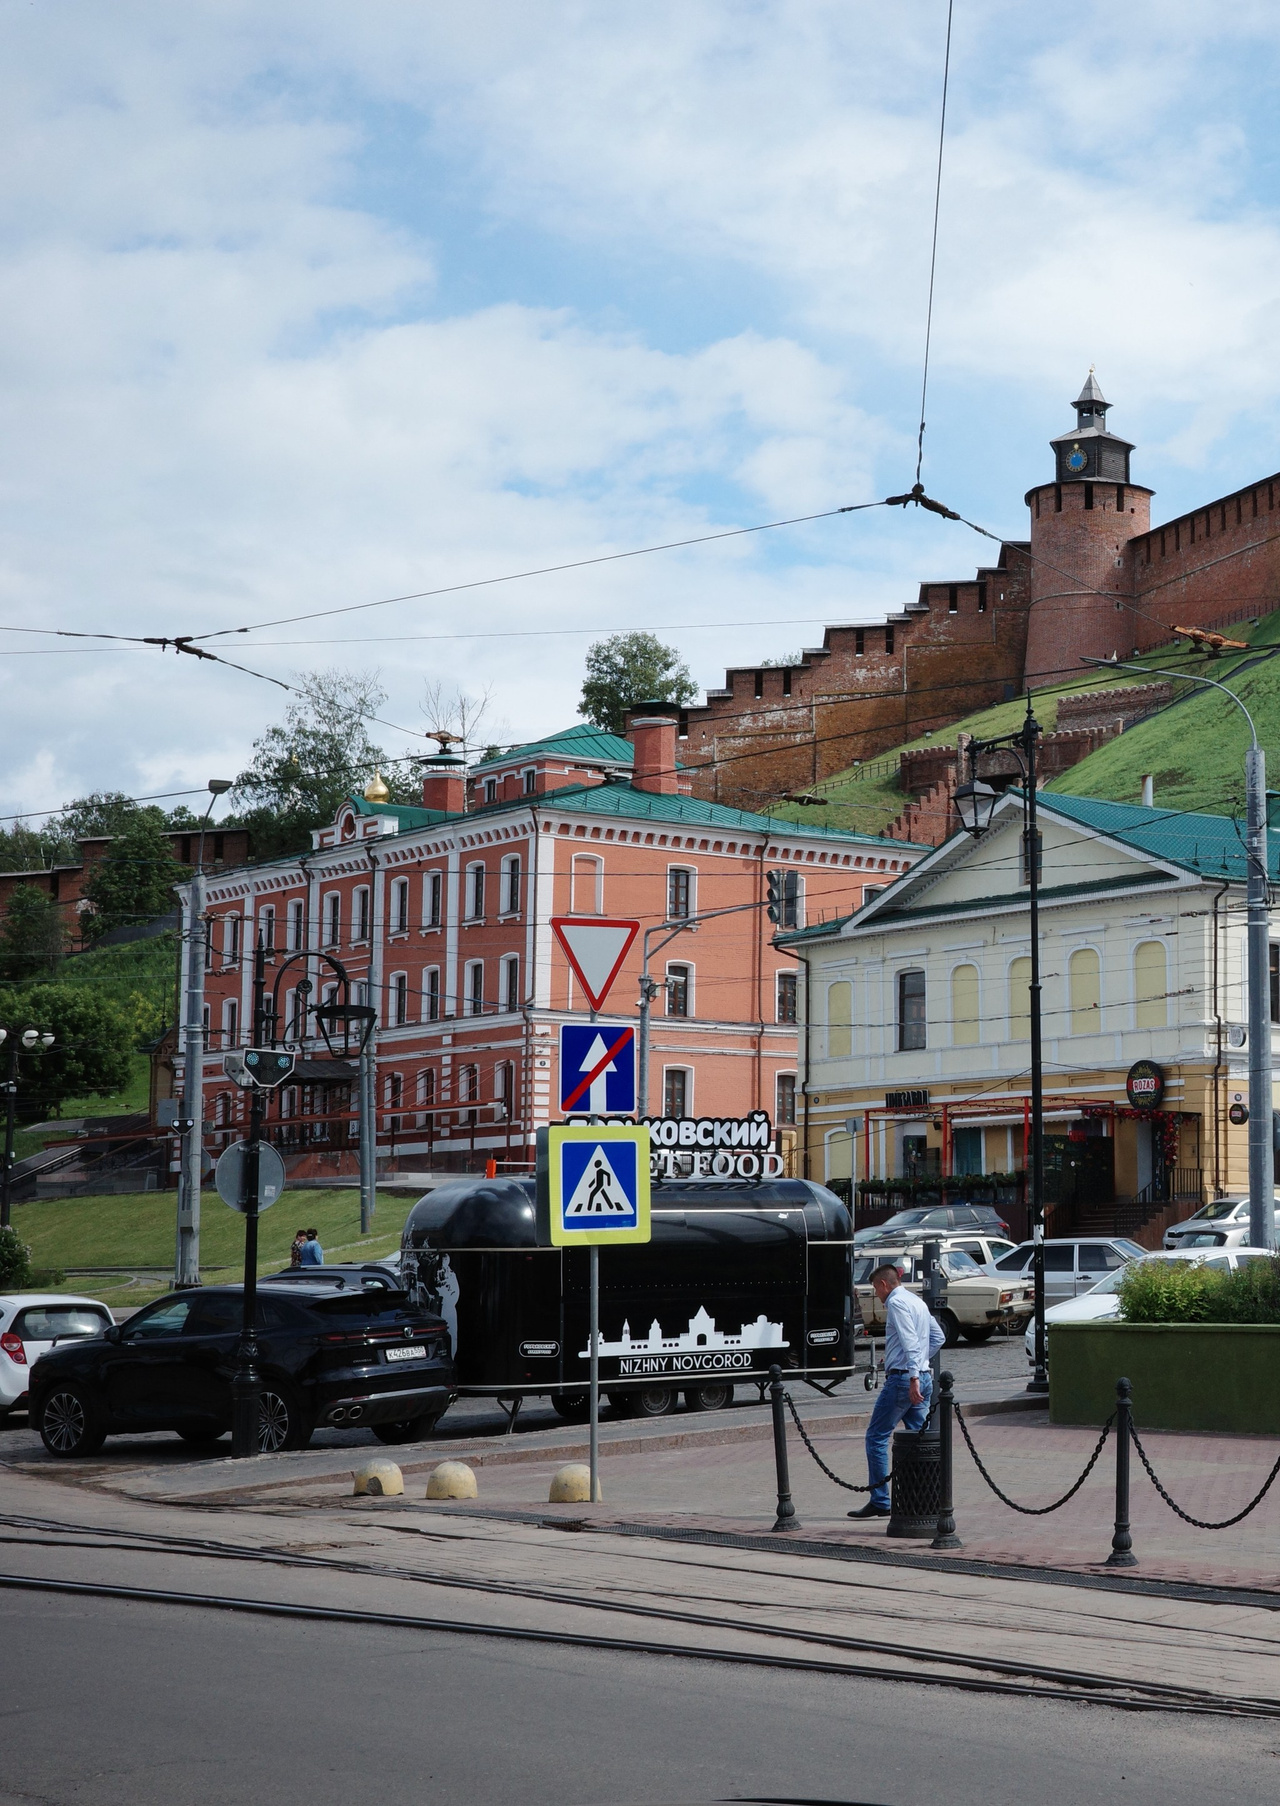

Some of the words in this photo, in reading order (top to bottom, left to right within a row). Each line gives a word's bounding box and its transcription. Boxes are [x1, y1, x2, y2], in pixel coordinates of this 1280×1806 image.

[1133, 1080, 1155, 1091] ROZAS
[569, 1114, 768, 1146] КОВСКИЙ
[688, 1153, 784, 1178] FOOD
[620, 1357, 668, 1374] NIZHNY
[673, 1352, 752, 1371] NOVGOROD
